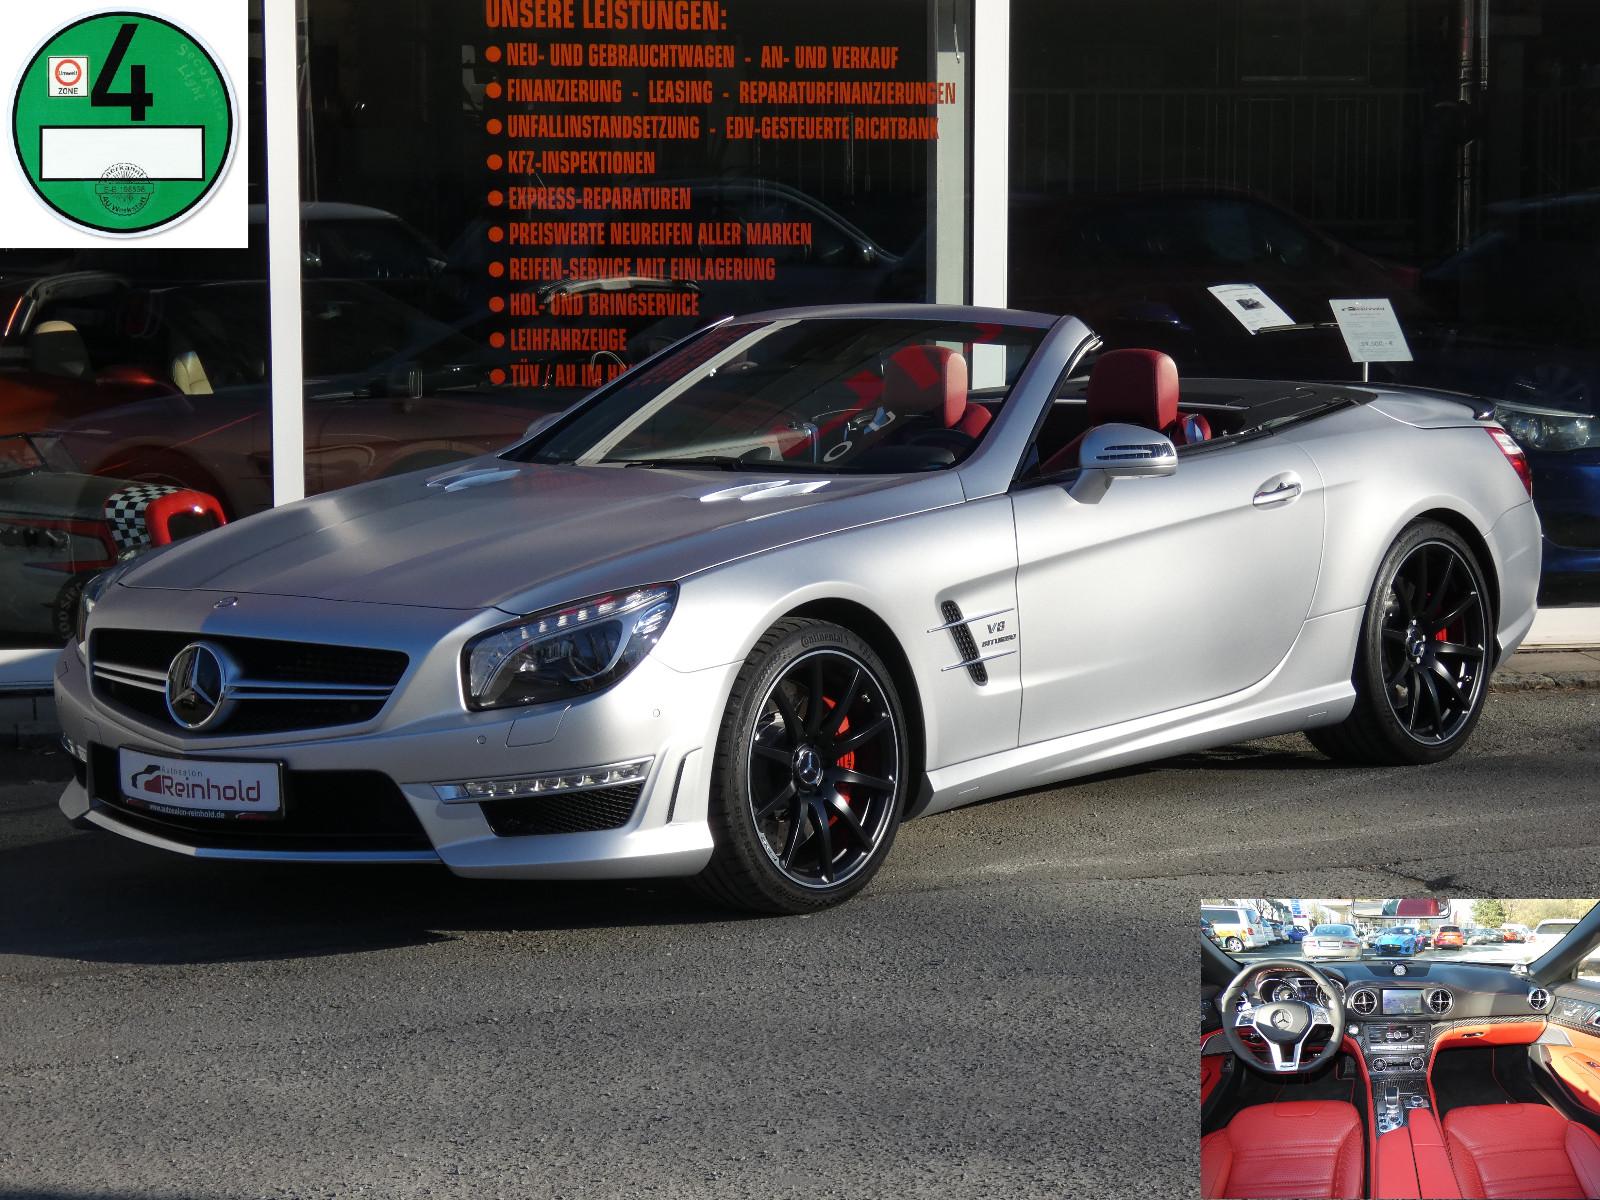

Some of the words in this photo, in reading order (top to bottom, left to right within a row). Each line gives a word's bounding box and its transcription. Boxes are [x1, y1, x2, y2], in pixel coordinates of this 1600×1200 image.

[485, 0, 575, 29] UNSERE
[582, 0, 728, 31] LEISTUNGEN:
[506, 43, 545, 67] NEU-
[549, 43, 584, 67] UND
[588, 43, 735, 68] GEBRAUCHTWAGEN
[760, 45, 791, 68] AN-
[795, 46, 827, 69] UND
[832, 46, 899, 69] VERKAUF
[507, 79, 623, 103] FINANZIERUNG
[648, 80, 713, 104] LEASING
[739, 80, 957, 105] REPARATURFINANZIERUNGEN
[507, 115, 700, 139] UNFALLINSTANDSETZUNG
[725, 116, 850, 140] EDV-GESTEUERTE
[854, 116, 940, 140] RICHTBANK
[508, 151, 656, 174] KFZ-INSPEKTIONEN
[508, 186, 691, 210] EXPRESS-REPARATUREN
[509, 222, 605, 245] PREISWERTE
[610, 222, 693, 245] NEUREIFEN
[698, 223, 742, 245] ALLER
[746, 223, 812, 245] MARKEN
[509, 257, 631, 281] REIFEN-SERVICE
[636, 257, 667, 280] MIT
[670, 257, 776, 281] EINLAGERUNG
[510, 293, 545, 316] HOL-
[551, 293, 584, 317] UND
[589, 293, 699, 316] BRINGSERVICE
[511, 328, 628, 351] LEIHFAHRZEUGE
[511, 358, 540, 387] TÜV
[555, 364, 576, 387] AU
[582, 364, 603, 387] IM
[161, 767, 203, 777] Autosalon
[161, 776, 261, 802] Reinhold
